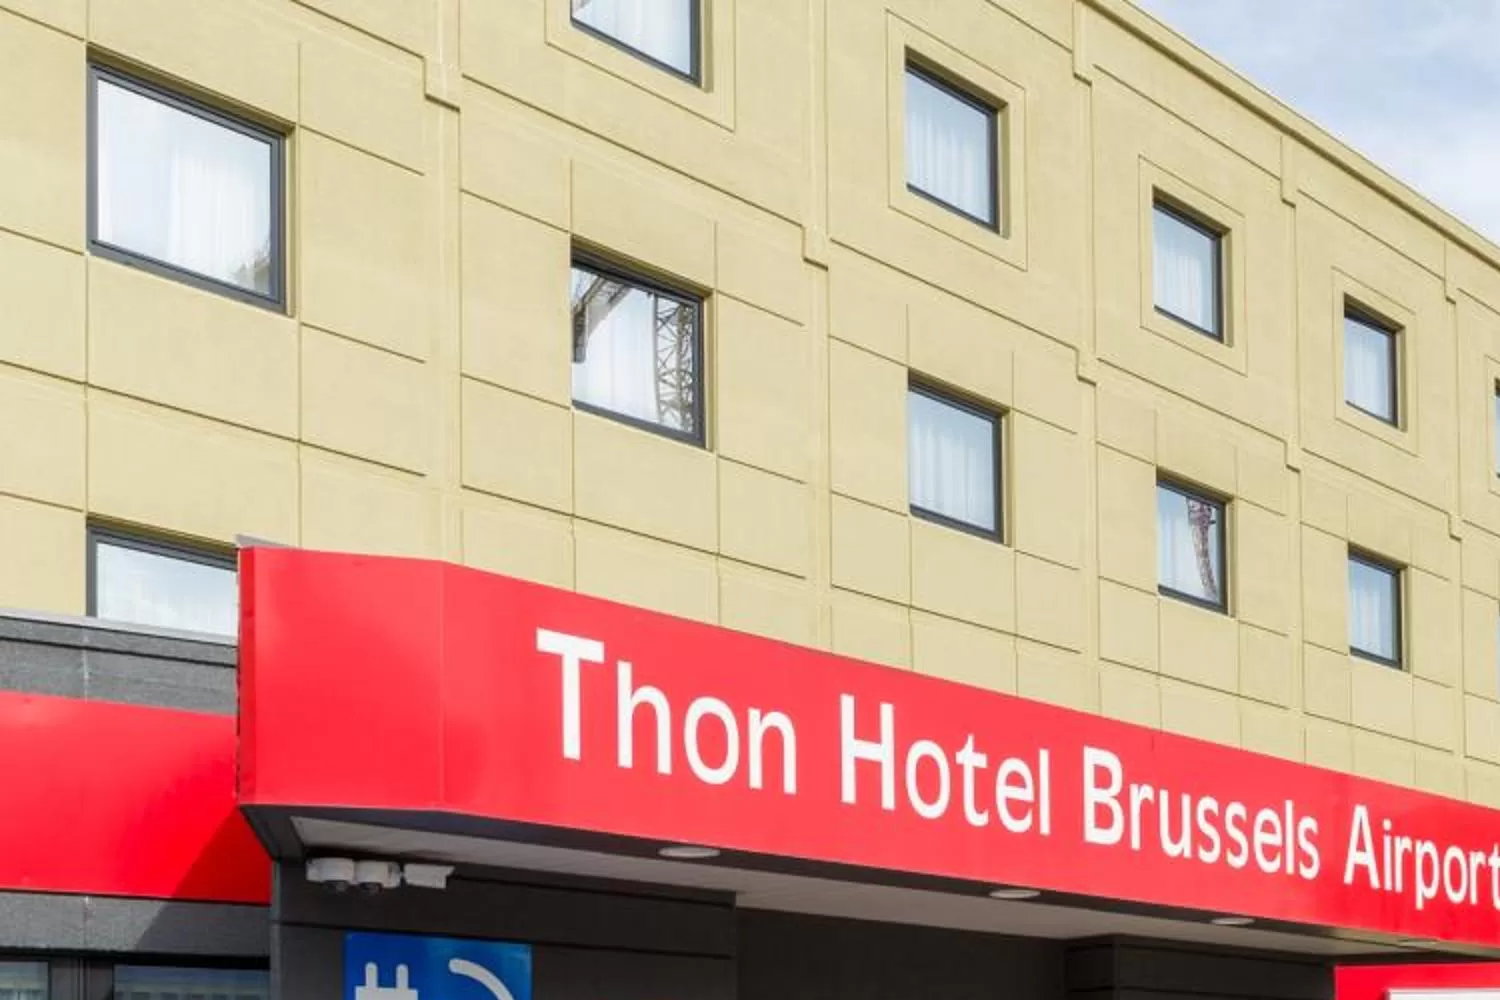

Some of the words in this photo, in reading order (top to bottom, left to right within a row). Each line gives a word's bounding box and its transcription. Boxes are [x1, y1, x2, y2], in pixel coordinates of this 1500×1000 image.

[536, 628, 797, 795] Thon
[840, 693, 1051, 836] Hotel
[1083, 745, 1321, 881] Brussels
